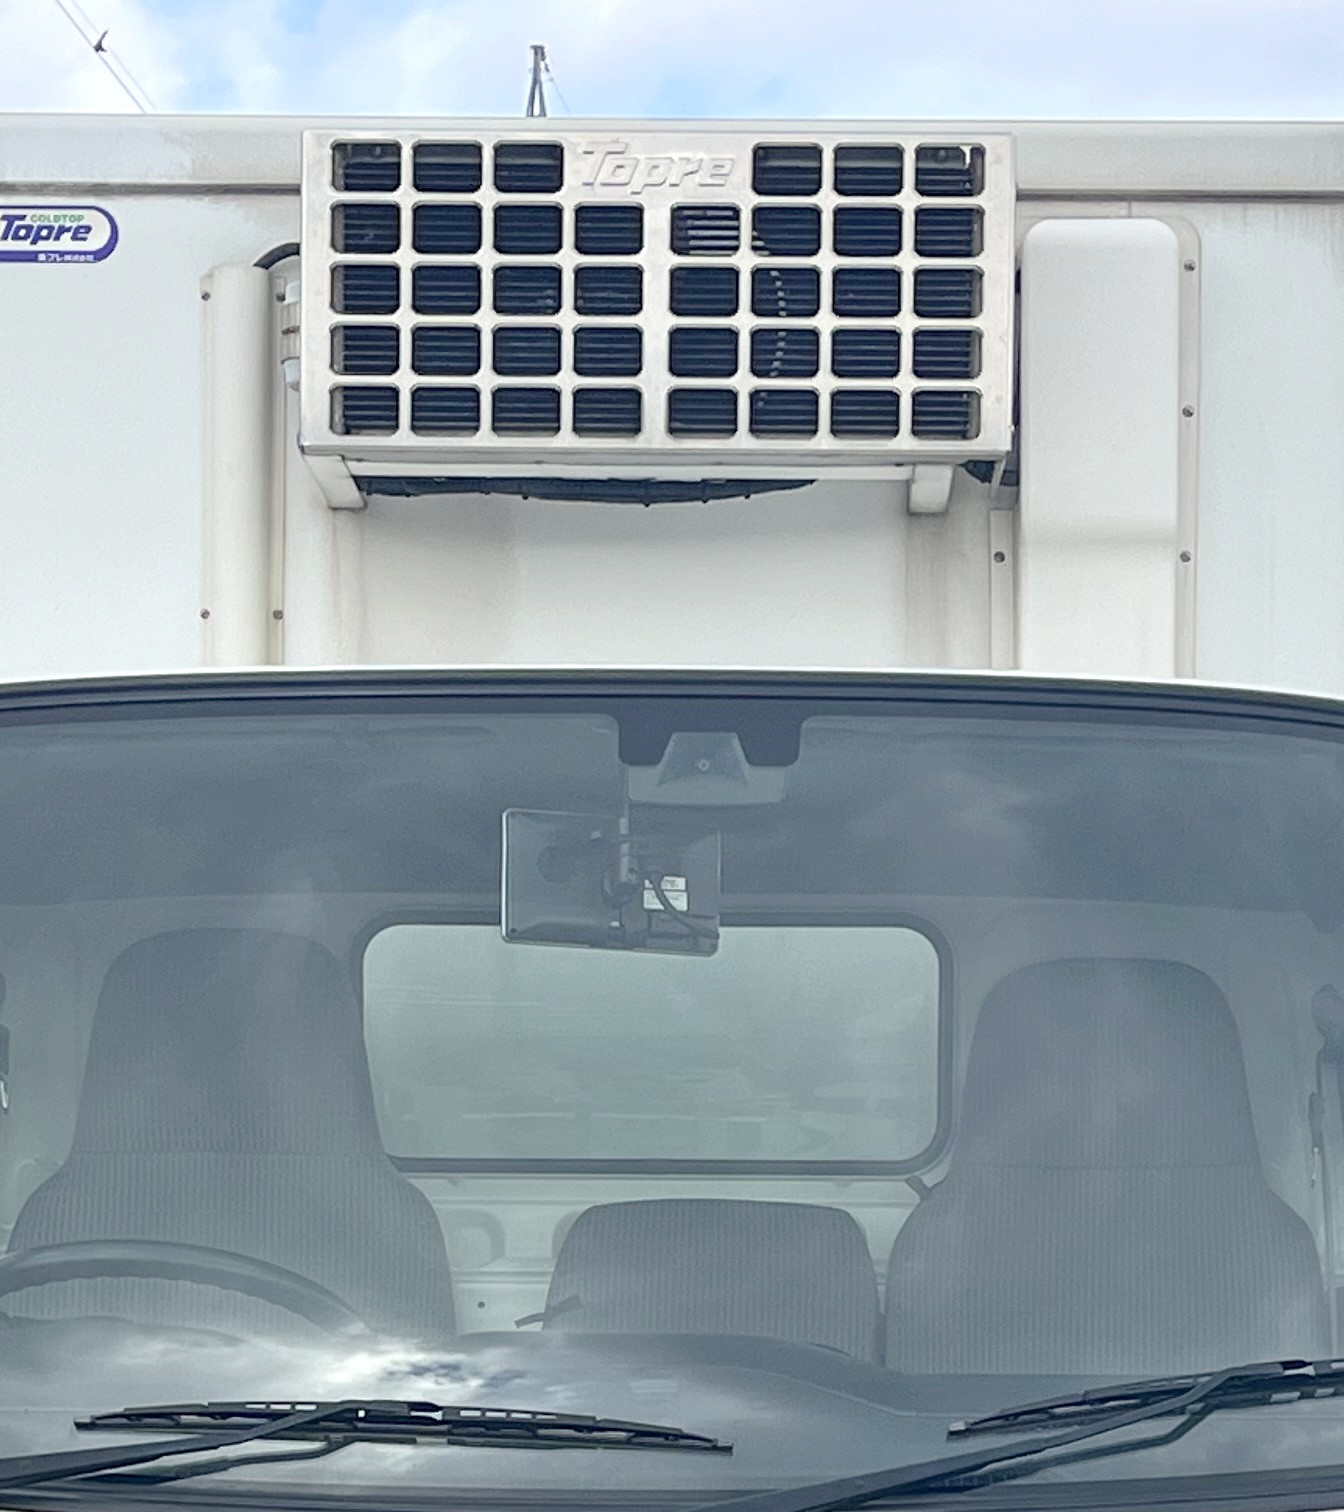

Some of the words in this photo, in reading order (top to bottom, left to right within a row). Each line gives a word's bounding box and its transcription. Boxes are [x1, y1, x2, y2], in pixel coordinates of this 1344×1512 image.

[582, 140, 735, 195] Topre
[0, 214, 93, 245] Topre
[29, 213, 85, 223] COLDTOP
